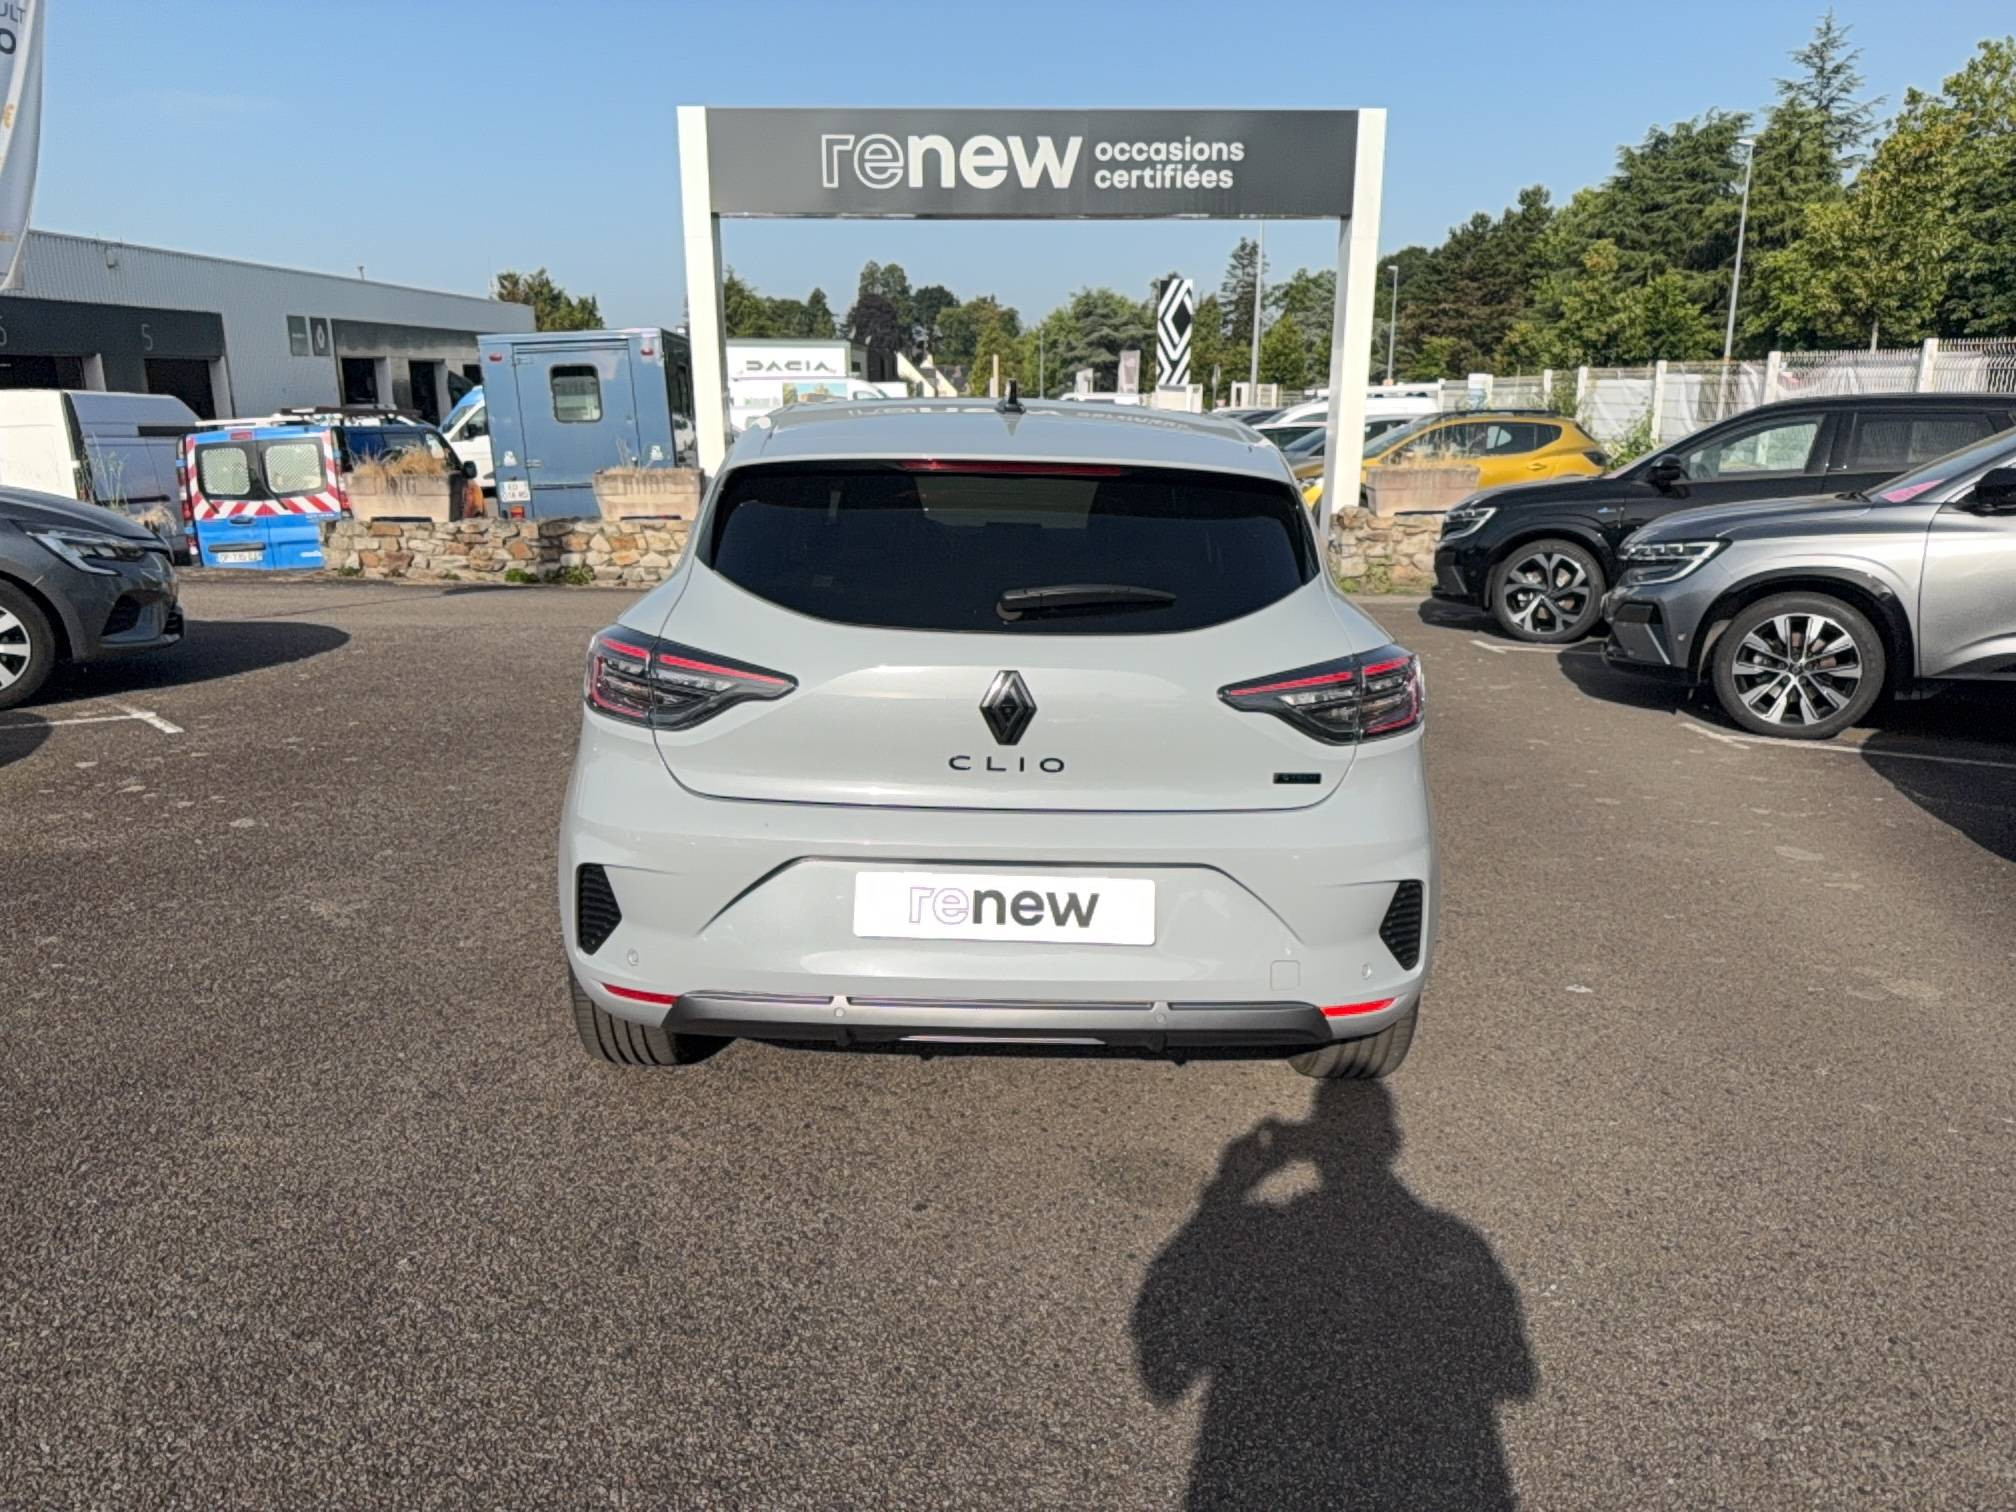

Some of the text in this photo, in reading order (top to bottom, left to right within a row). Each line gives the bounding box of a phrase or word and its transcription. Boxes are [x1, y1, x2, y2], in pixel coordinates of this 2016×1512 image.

[821, 133, 1083, 189] renew
[1094, 136, 1245, 162] occasions
[1094, 164, 1234, 189] certifiées
[141, 323, 154, 351] 5
[745, 359, 831, 372] DACIA
[948, 755, 1065, 773] CLIO
[908, 886, 1100, 929] renew
